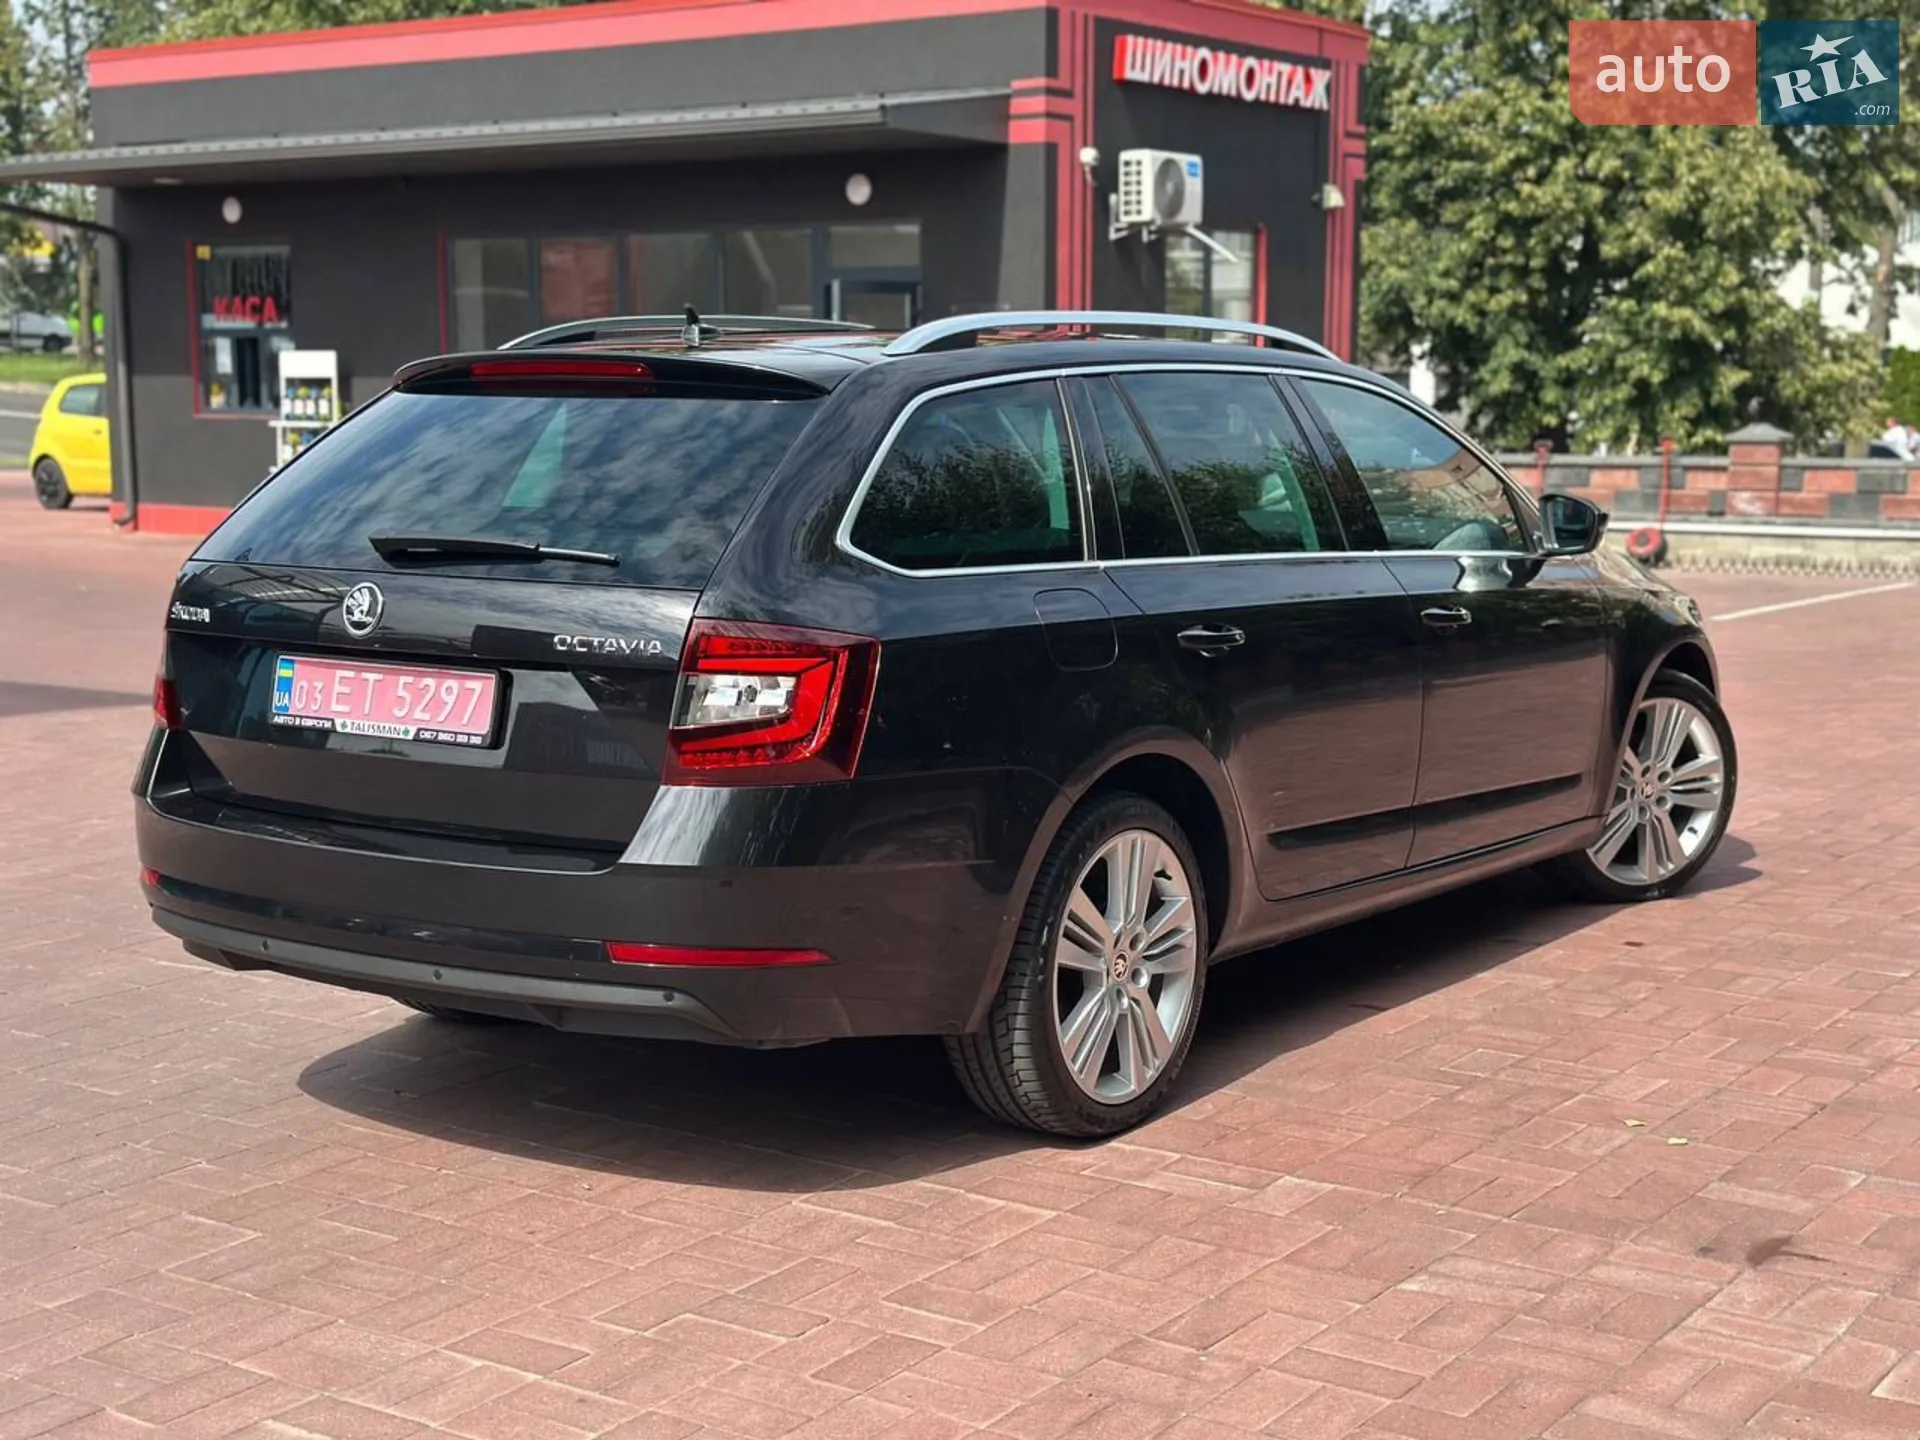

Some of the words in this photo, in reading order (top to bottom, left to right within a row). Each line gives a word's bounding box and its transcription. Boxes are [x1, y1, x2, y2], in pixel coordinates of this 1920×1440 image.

[1115, 34, 1332, 111] ШИНОМОНТАЖ
[213, 295, 281, 323] КАСА
[553, 635, 663, 656] OCTAVIA
[275, 690, 290, 707] UA
[294, 679, 325, 712] 03
[330, 669, 384, 717] ET
[392, 675, 485, 727] 5297
[350, 721, 400, 736] TALISMAN
